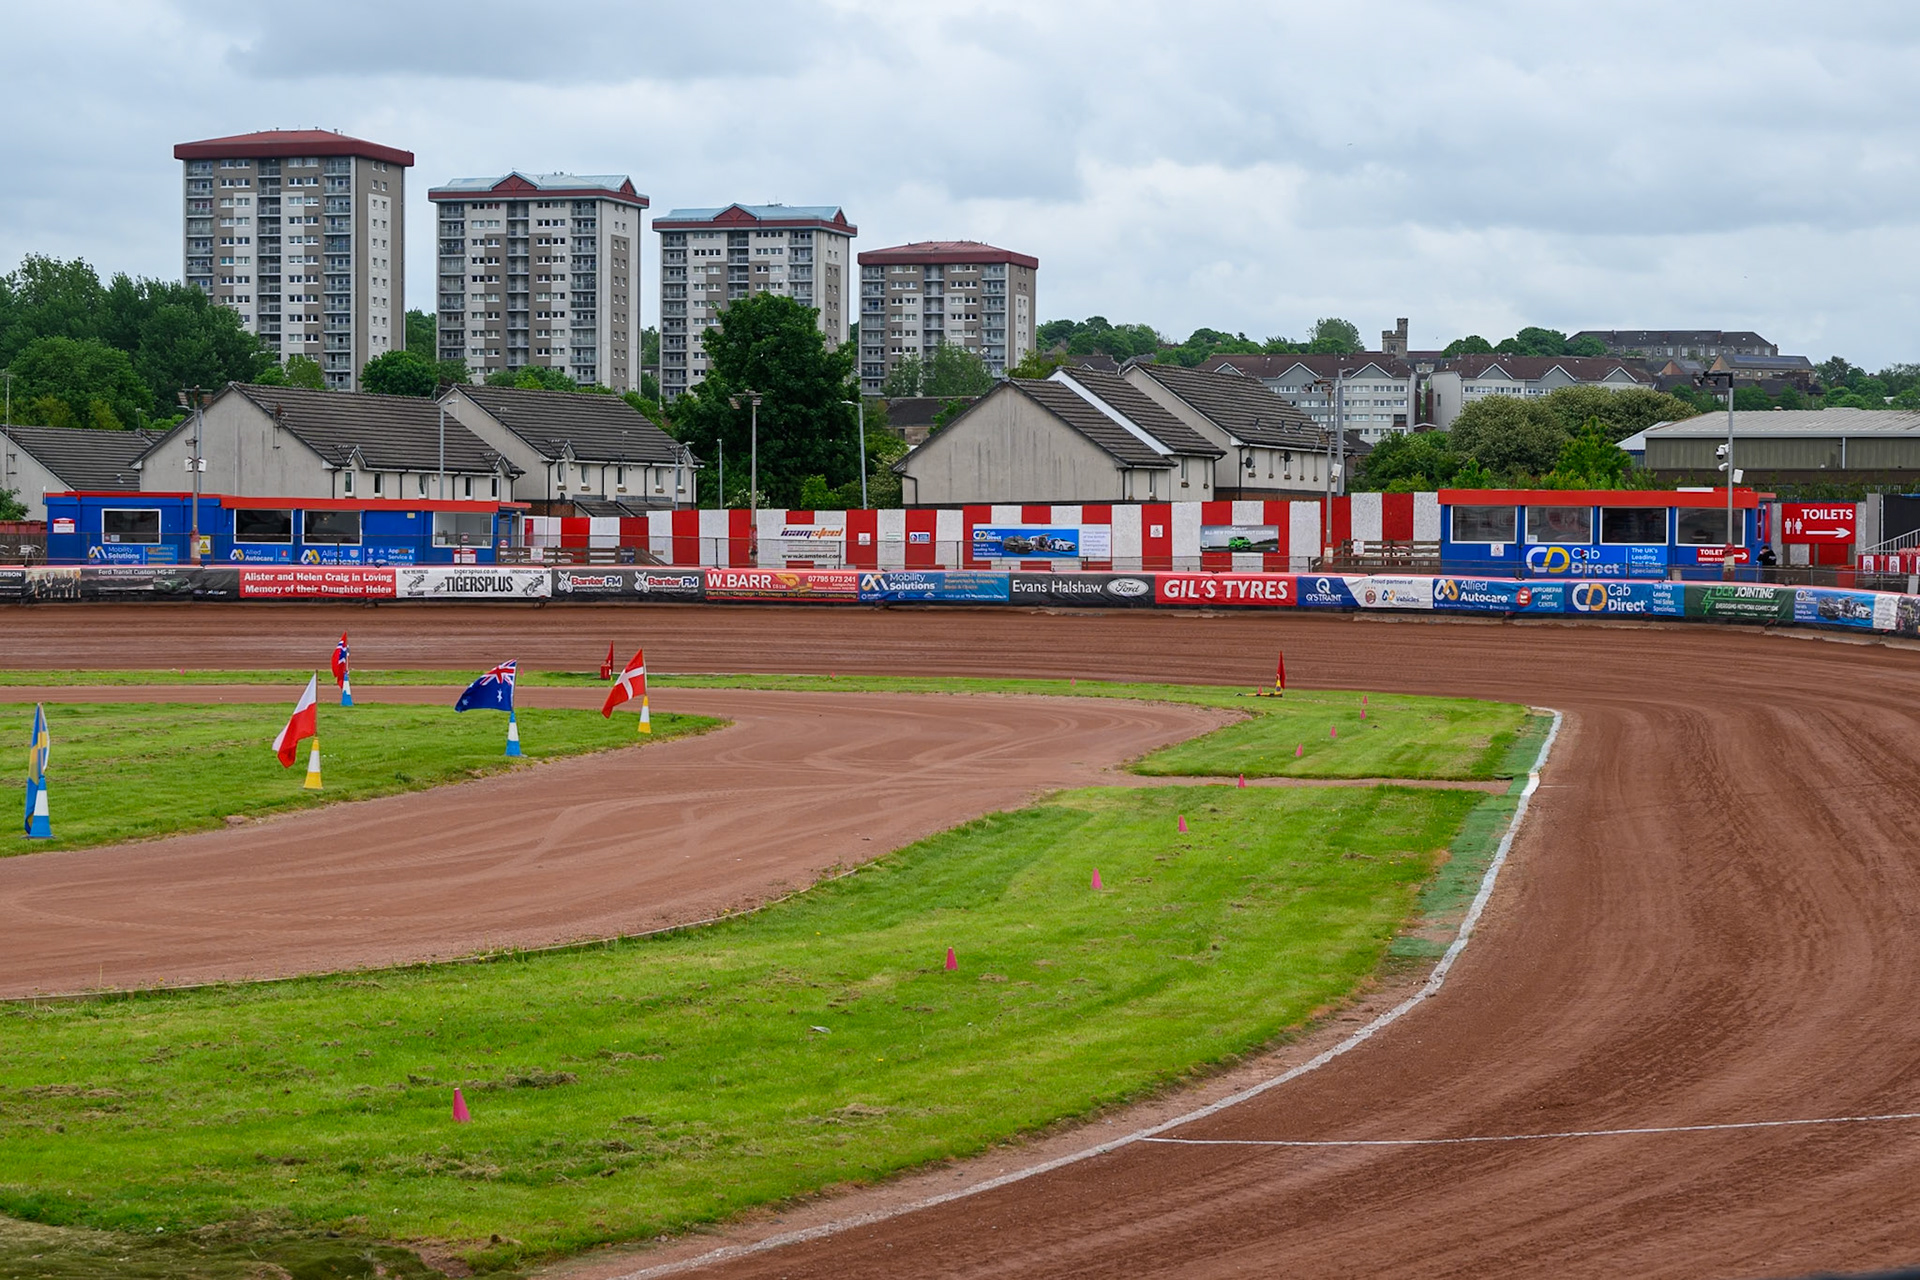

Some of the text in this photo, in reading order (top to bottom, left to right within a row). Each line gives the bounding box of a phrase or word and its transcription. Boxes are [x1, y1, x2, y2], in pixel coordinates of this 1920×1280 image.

[1801, 509, 1853, 520] TOILETS
[781, 527, 844, 538] icamsteel
[1571, 547, 1600, 559] Cab
[1571, 560, 1620, 574] Direct
[244, 572, 274, 581] Alister
[325, 573, 349, 582] Craig
[363, 574, 392, 582] Loving
[571, 576, 622, 586] Banter FM
[648, 577, 698, 587] Banter FM
[890, 574, 925, 582] Mobility
[245, 585, 283, 594] Memory
[321, 585, 363, 594] Daughter
[445, 577, 513, 592] TIGERSPLUS
[890, 582, 935, 591] Solutions
[1012, 580, 1102, 593] Evans Halshaw
[1115, 582, 1140, 593] Ford
[1164, 580, 1288, 599] GIL'S TYRES
[1460, 580, 1487, 590] Allied
[1608, 584, 1631, 596] Cab
[1460, 592, 1508, 603] Autocare
[1716, 586, 1774, 598] DCR JOINTING
[1608, 598, 1646, 612] Direct
